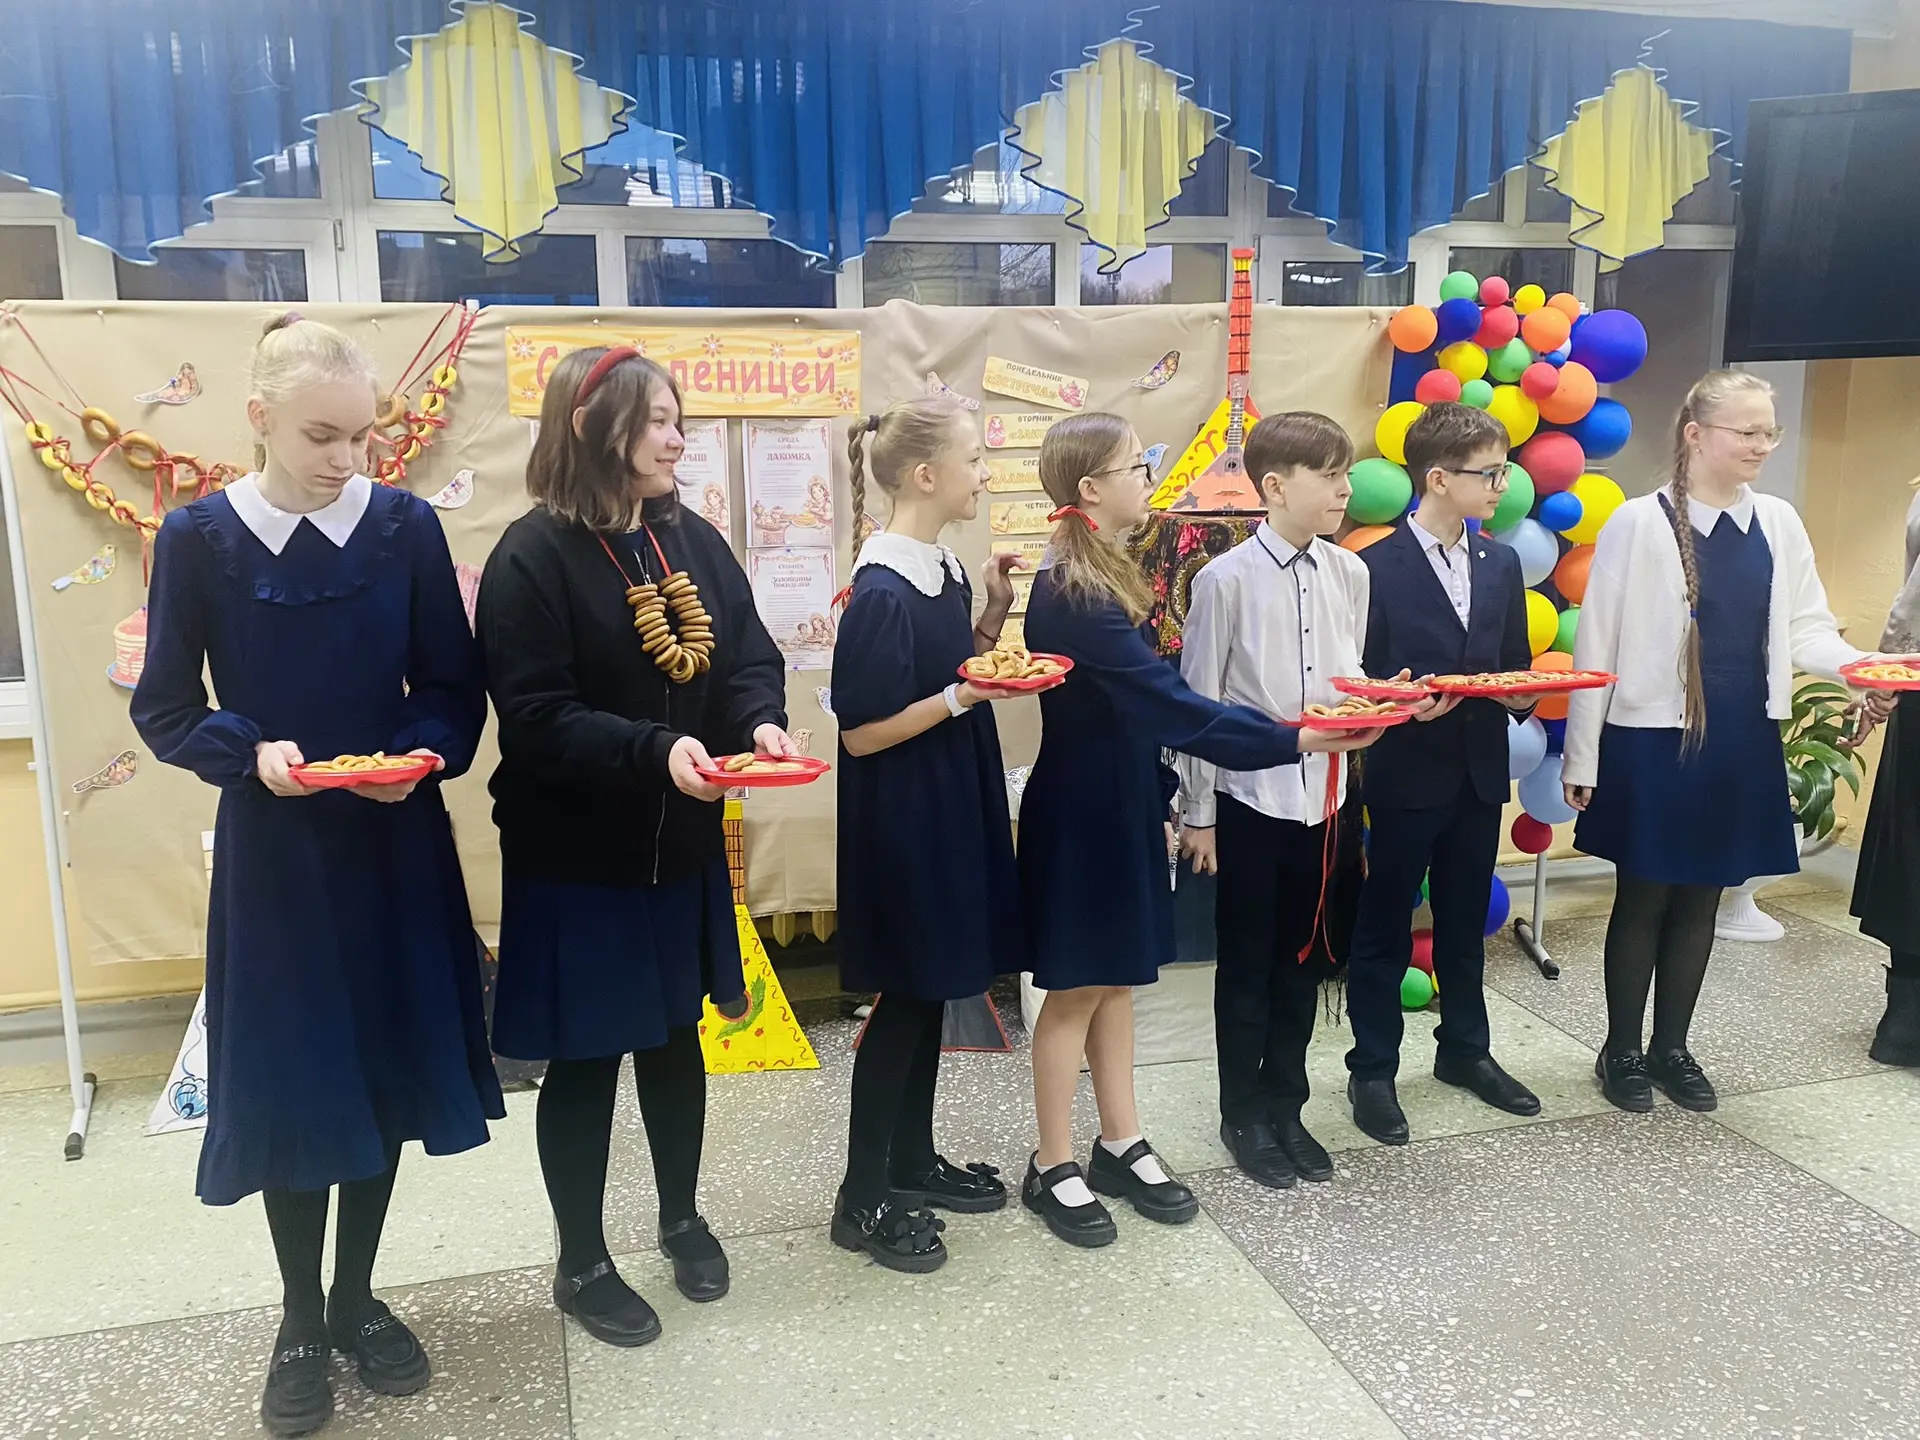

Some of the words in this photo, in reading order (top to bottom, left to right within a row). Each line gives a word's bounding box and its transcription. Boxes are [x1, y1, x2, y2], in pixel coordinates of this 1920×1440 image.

[669, 346, 836, 398] леницей
[1006, 362, 1063, 383] ПОНЕДЕЛЬНИК
[1017, 415, 1053, 423] ВТОРНИК
[766, 452, 812, 461] ЛАКОМКА
[1022, 459, 1040, 467] СРЕ
[1025, 502, 1055, 510] ЧЕТВЕР
